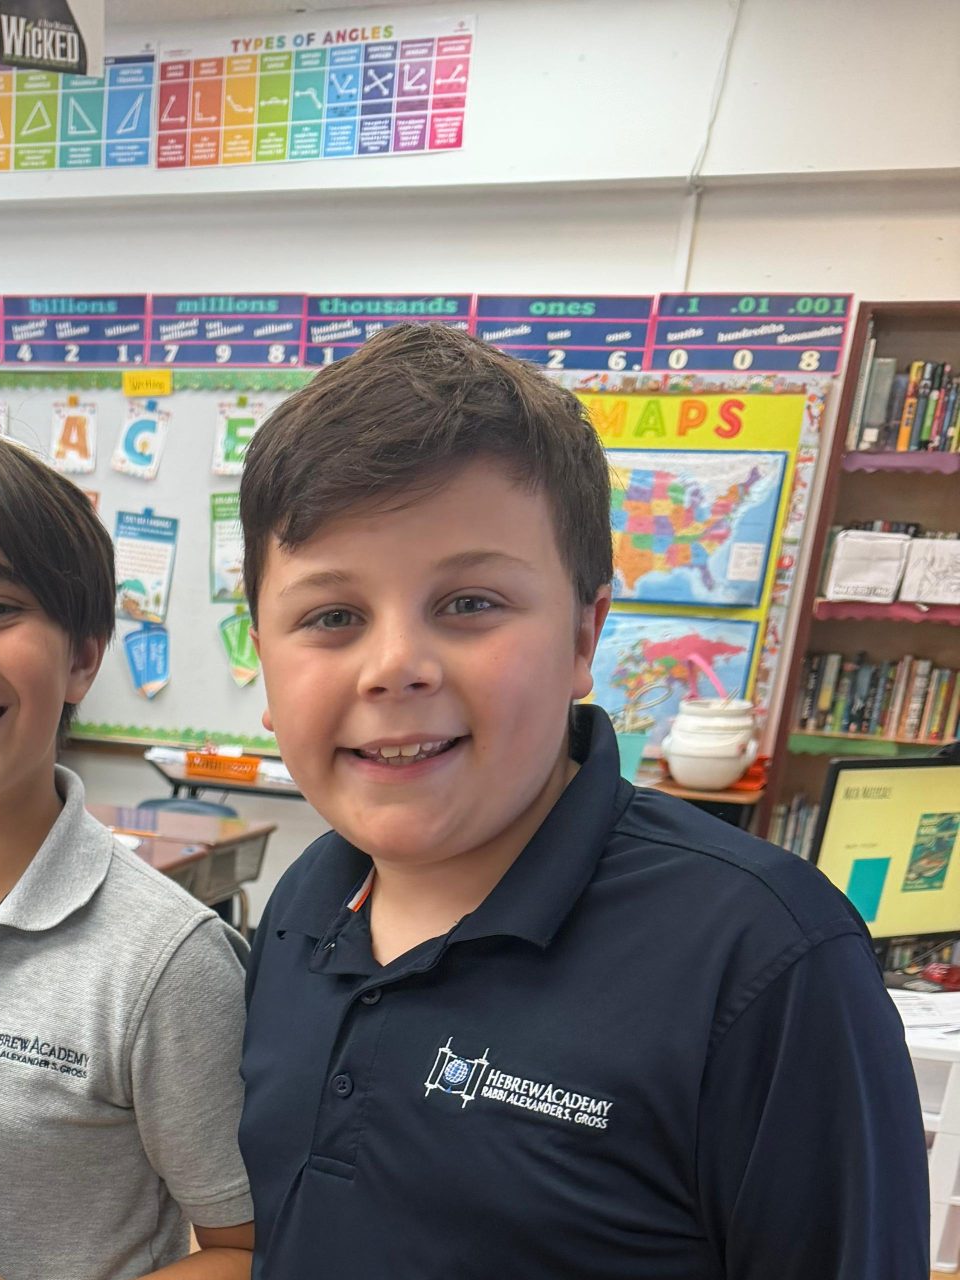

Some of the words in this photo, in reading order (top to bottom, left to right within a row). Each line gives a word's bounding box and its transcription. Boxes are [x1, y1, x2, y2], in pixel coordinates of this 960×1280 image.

[230, 35, 286, 52] TYPES
[292, 30, 315, 47] OF
[322, 25, 394, 45] ANGLES
[28, 298, 118, 314] billions
[175, 297, 279, 314] millions
[318, 297, 459, 315] thousands
[528, 301, 596, 316] ones
[676, 297, 700, 314] .1
[730, 297, 770, 314] .01
[788, 297, 846, 315] .001
[16, 343, 33, 362] 4
[64, 343, 80, 362] 2
[163, 344, 179, 363] 7
[215, 344, 232, 363] 9
[546, 350, 566, 369] 2
[668, 348, 689, 370] 0
[733, 349, 754, 371] 0
[798, 350, 821, 371] 8
[589, 398, 746, 439] MAPS
[55, 415, 91, 461] A
[122, 418, 159, 466] C
[481, 1085, 507, 1102] RABBI
[574, 1112, 609, 1129] GROSS
